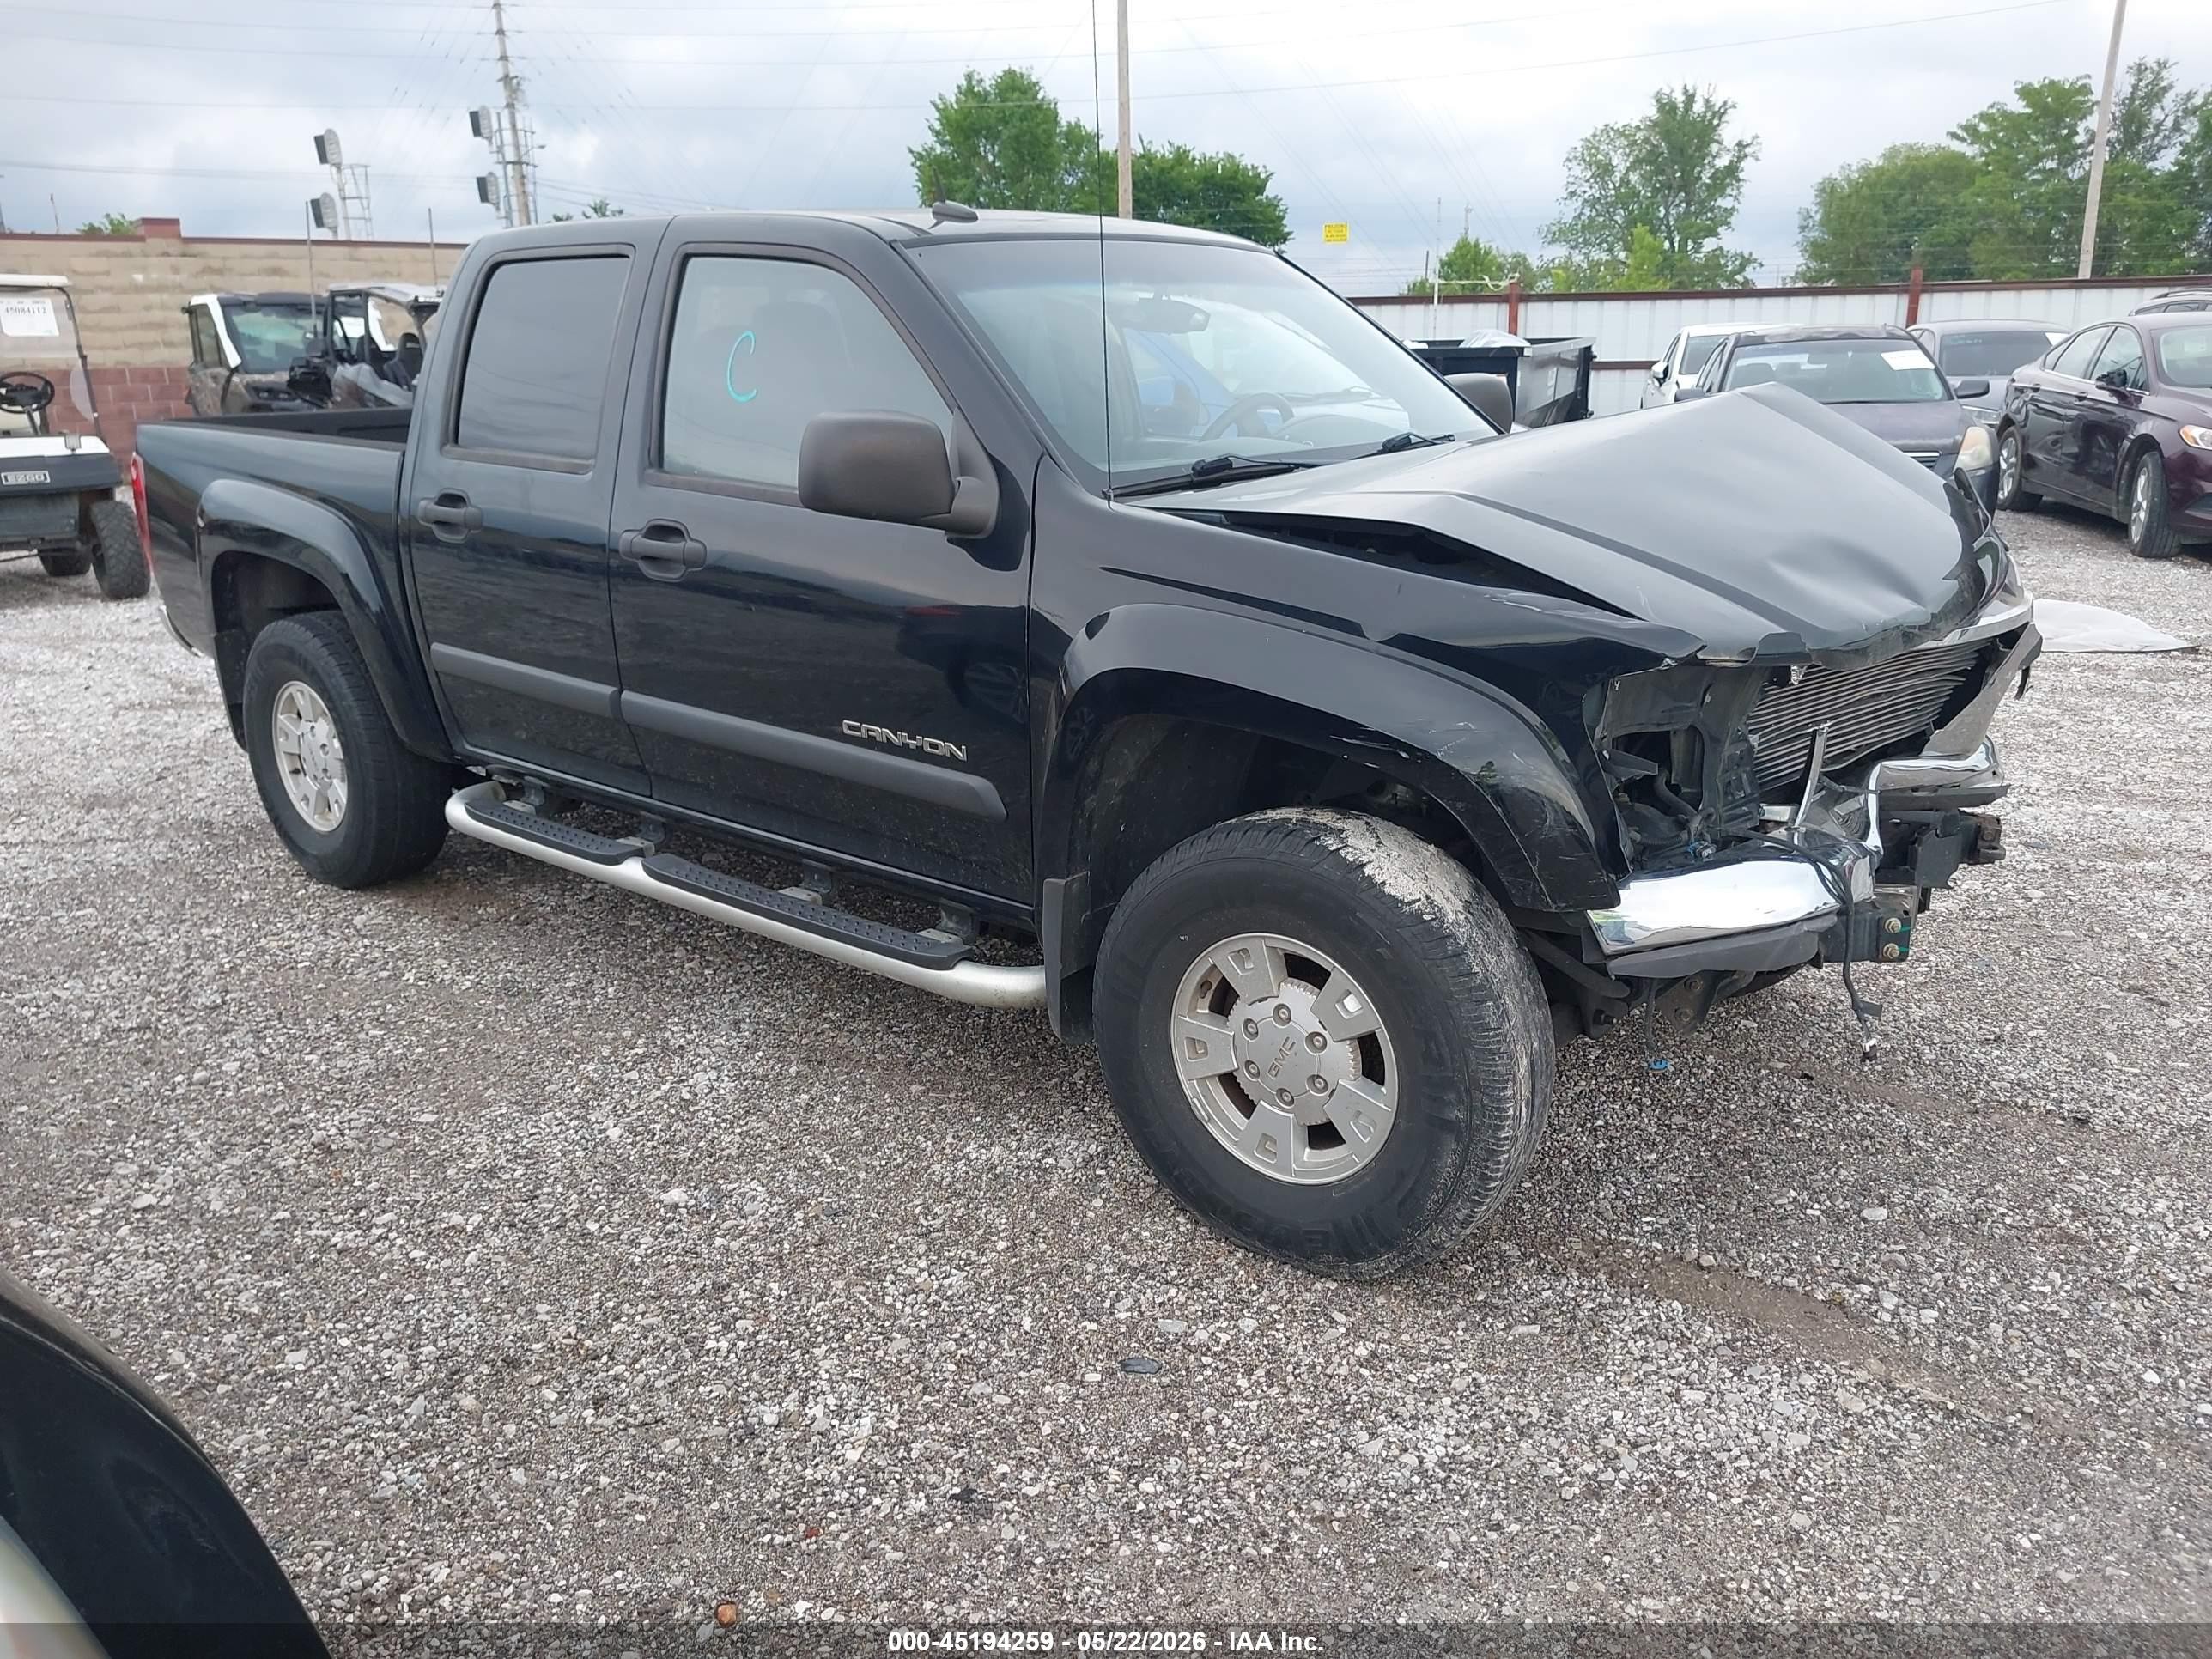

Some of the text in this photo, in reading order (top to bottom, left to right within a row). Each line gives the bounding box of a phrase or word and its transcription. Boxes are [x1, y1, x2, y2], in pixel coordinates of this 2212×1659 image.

[726, 329, 758, 403] C
[842, 720, 967, 762] CANYON
[1268, 1036, 1296, 1079] GMC
